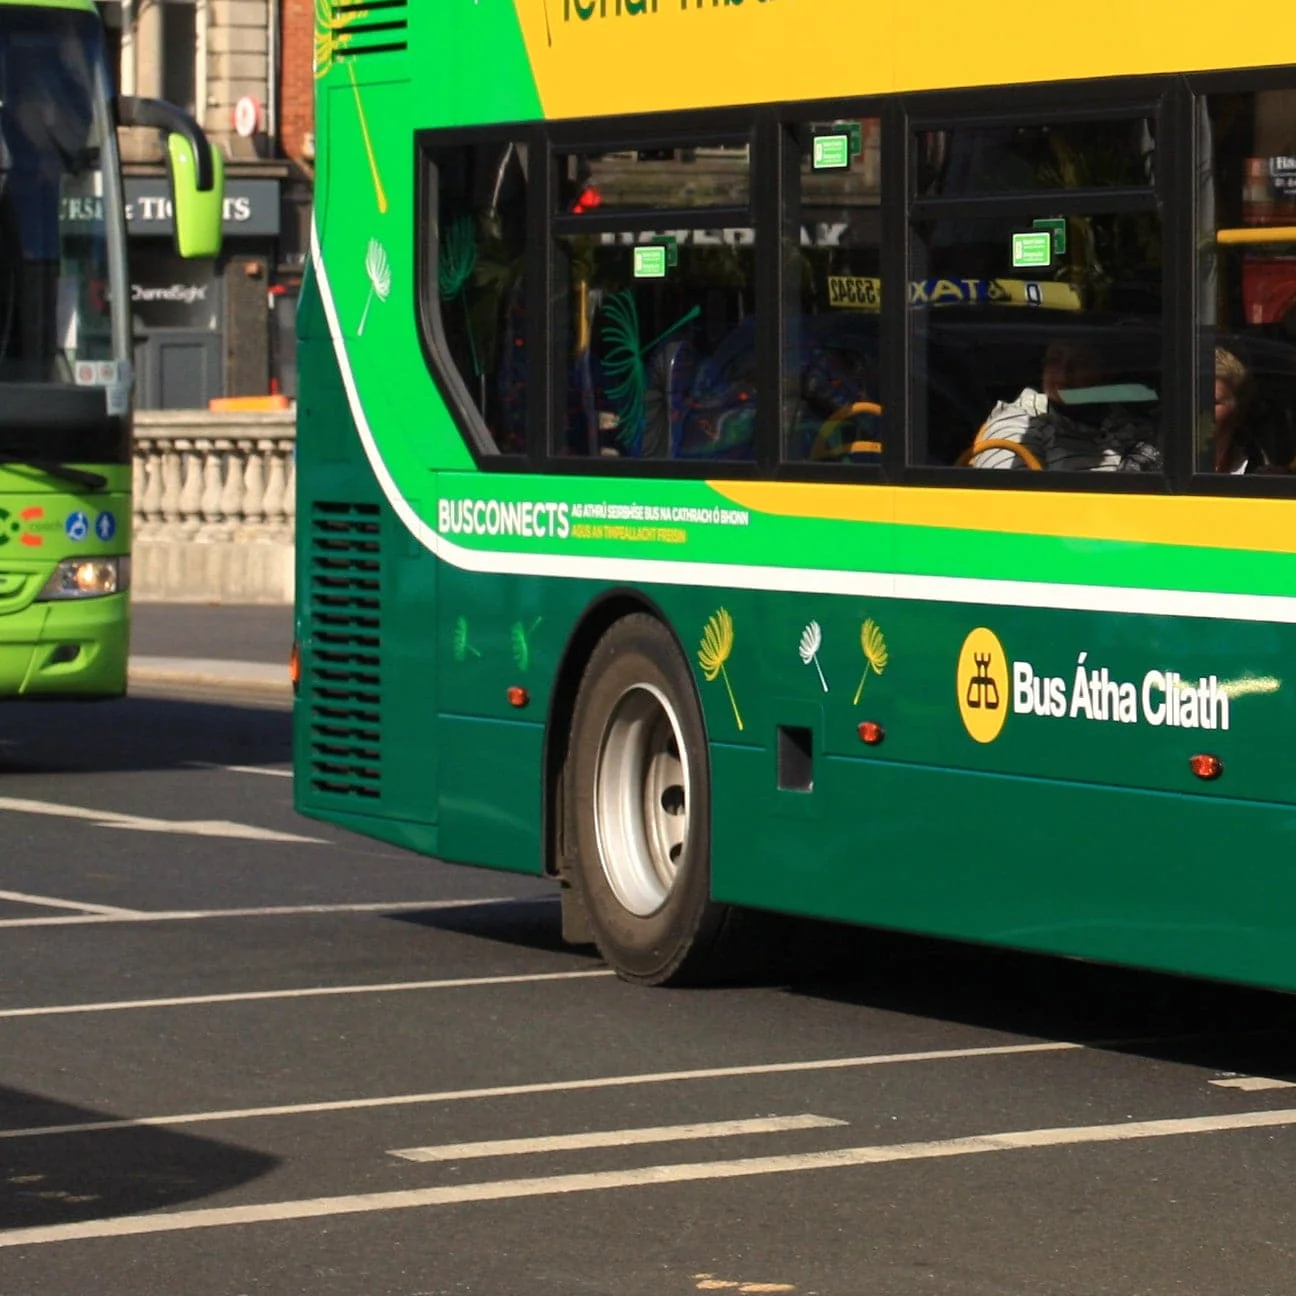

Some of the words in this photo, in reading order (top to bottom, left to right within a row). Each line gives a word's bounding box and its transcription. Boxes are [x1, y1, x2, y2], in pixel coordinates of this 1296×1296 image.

[438, 499, 570, 539] BUSCONNECTS
[1012, 661, 1066, 717] Bus
[1069, 651, 1138, 723] Átha
[1141, 669, 1230, 730] Cliath
